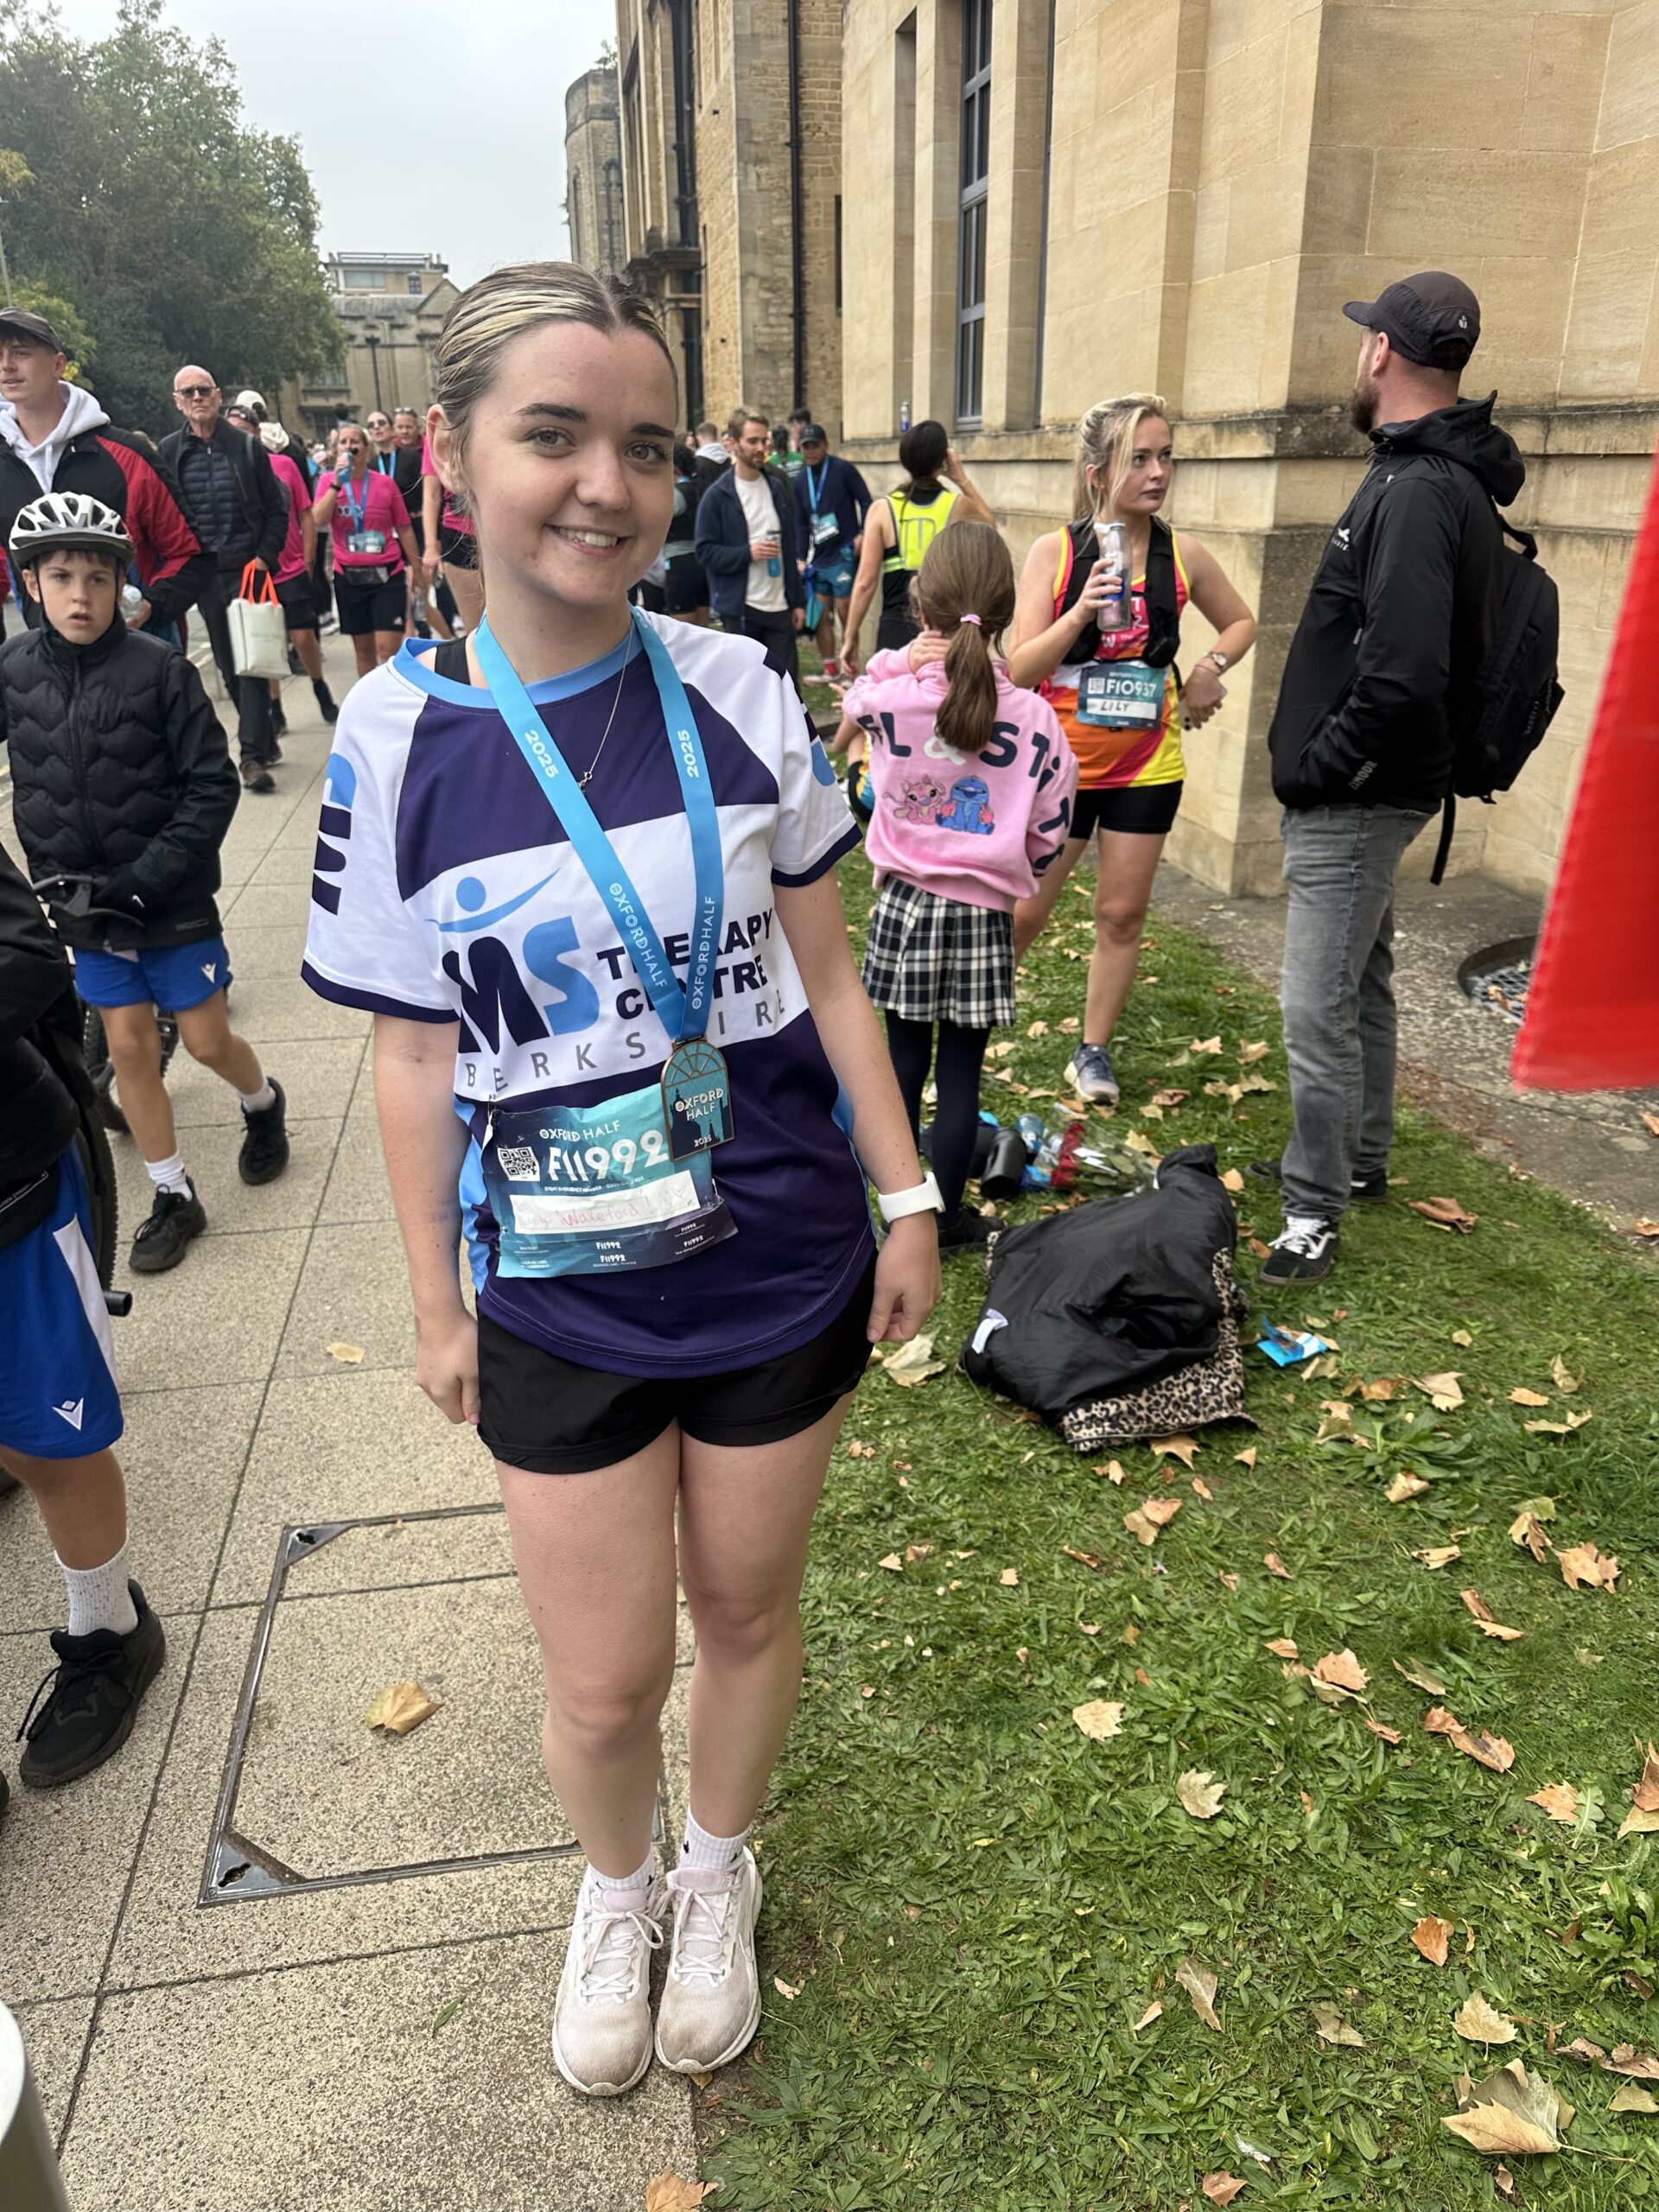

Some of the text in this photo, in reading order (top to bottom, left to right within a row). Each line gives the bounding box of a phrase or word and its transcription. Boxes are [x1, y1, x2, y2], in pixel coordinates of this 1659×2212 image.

[1105, 679, 1157, 697] F10937
[1100, 699, 1130, 713] LILY
[524, 729, 559, 779] 2025
[677, 729, 699, 779] 2025
[596, 907, 772, 981] TEAPY
[442, 916, 599, 1055] MS
[615, 954, 768, 1020] CTRE
[464, 988, 785, 1092] BERKSIRE
[675, 1088, 724, 1112] OXFORD
[686, 1102, 715, 1122] HALF
[539, 1120, 620, 1142] OXFORD HALF
[693, 1135, 712, 1147] 2025
[547, 1129, 669, 1182] F11992
[595, 1242, 621, 1250] F11992
[600, 1255, 626, 1263] F11992
